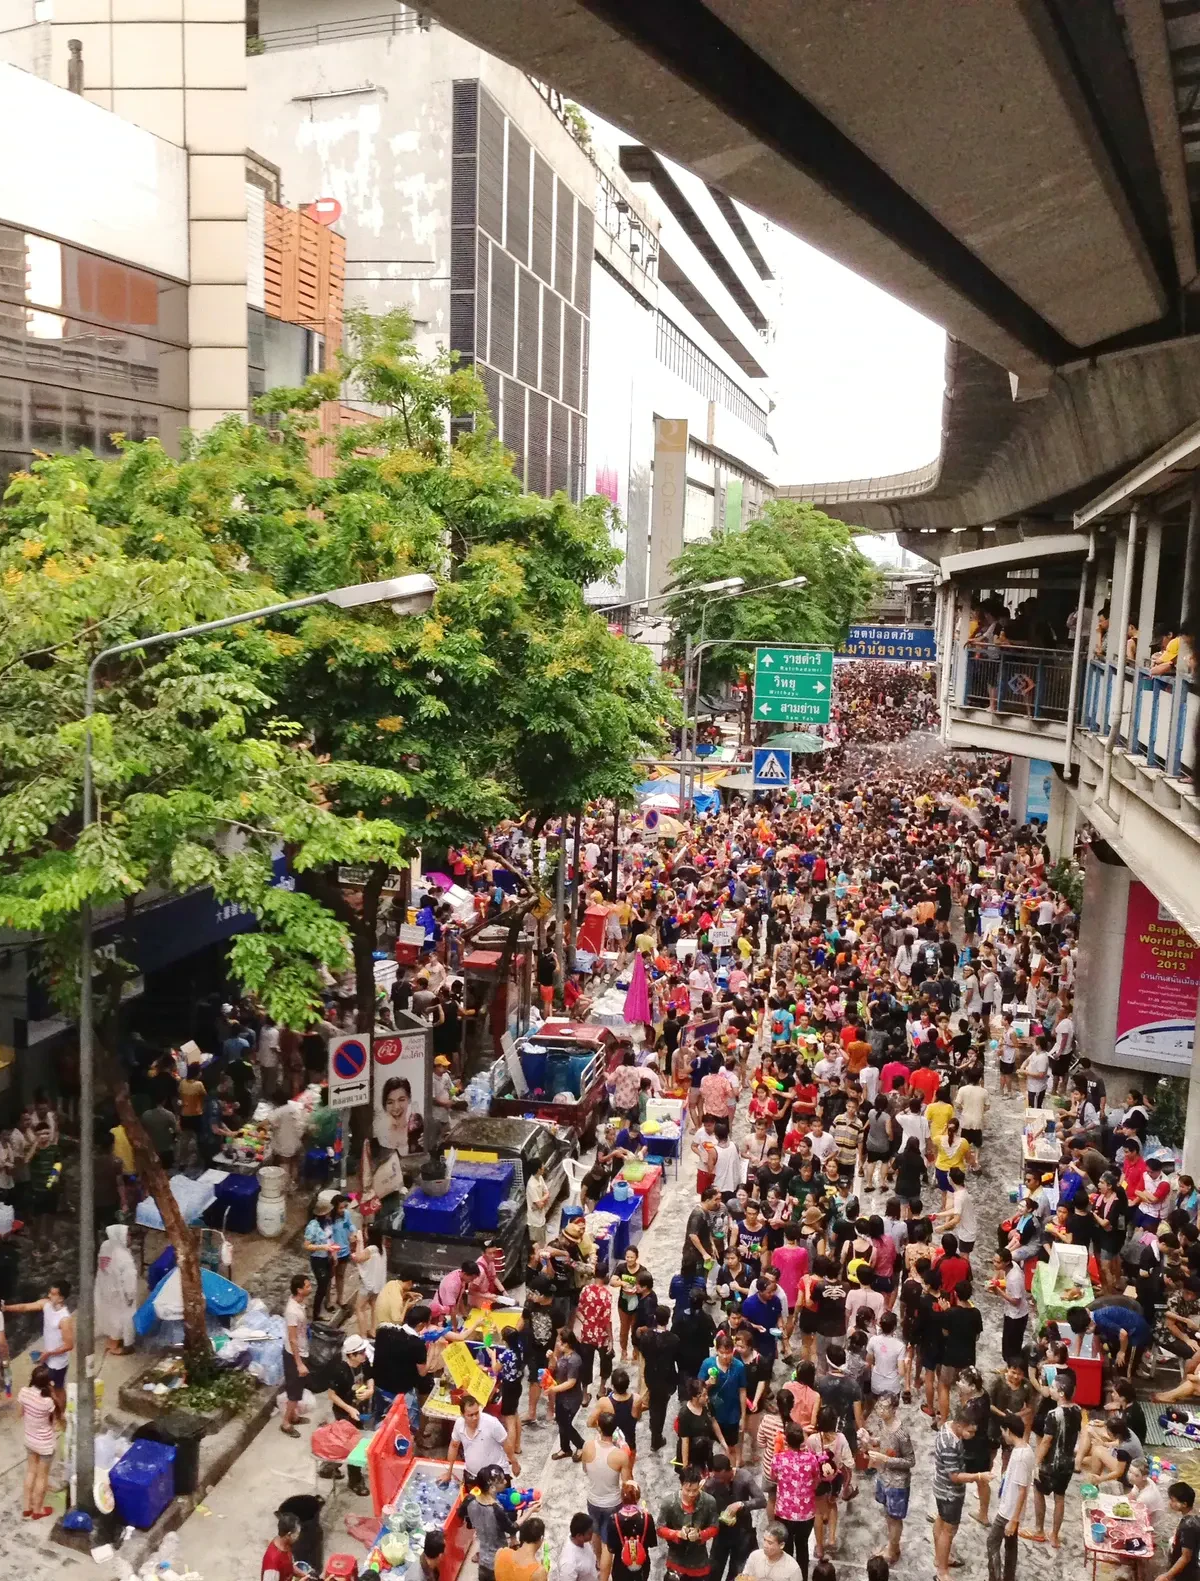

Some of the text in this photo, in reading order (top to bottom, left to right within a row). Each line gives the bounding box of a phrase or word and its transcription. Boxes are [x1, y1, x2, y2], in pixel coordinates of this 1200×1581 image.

[773, 675, 796, 692] วิทยุ
[780, 702, 820, 715] สามย่าน
[1139, 934, 1173, 946] World
[1151, 946, 1194, 960] Capital
[1156, 959, 1187, 971] 2013
